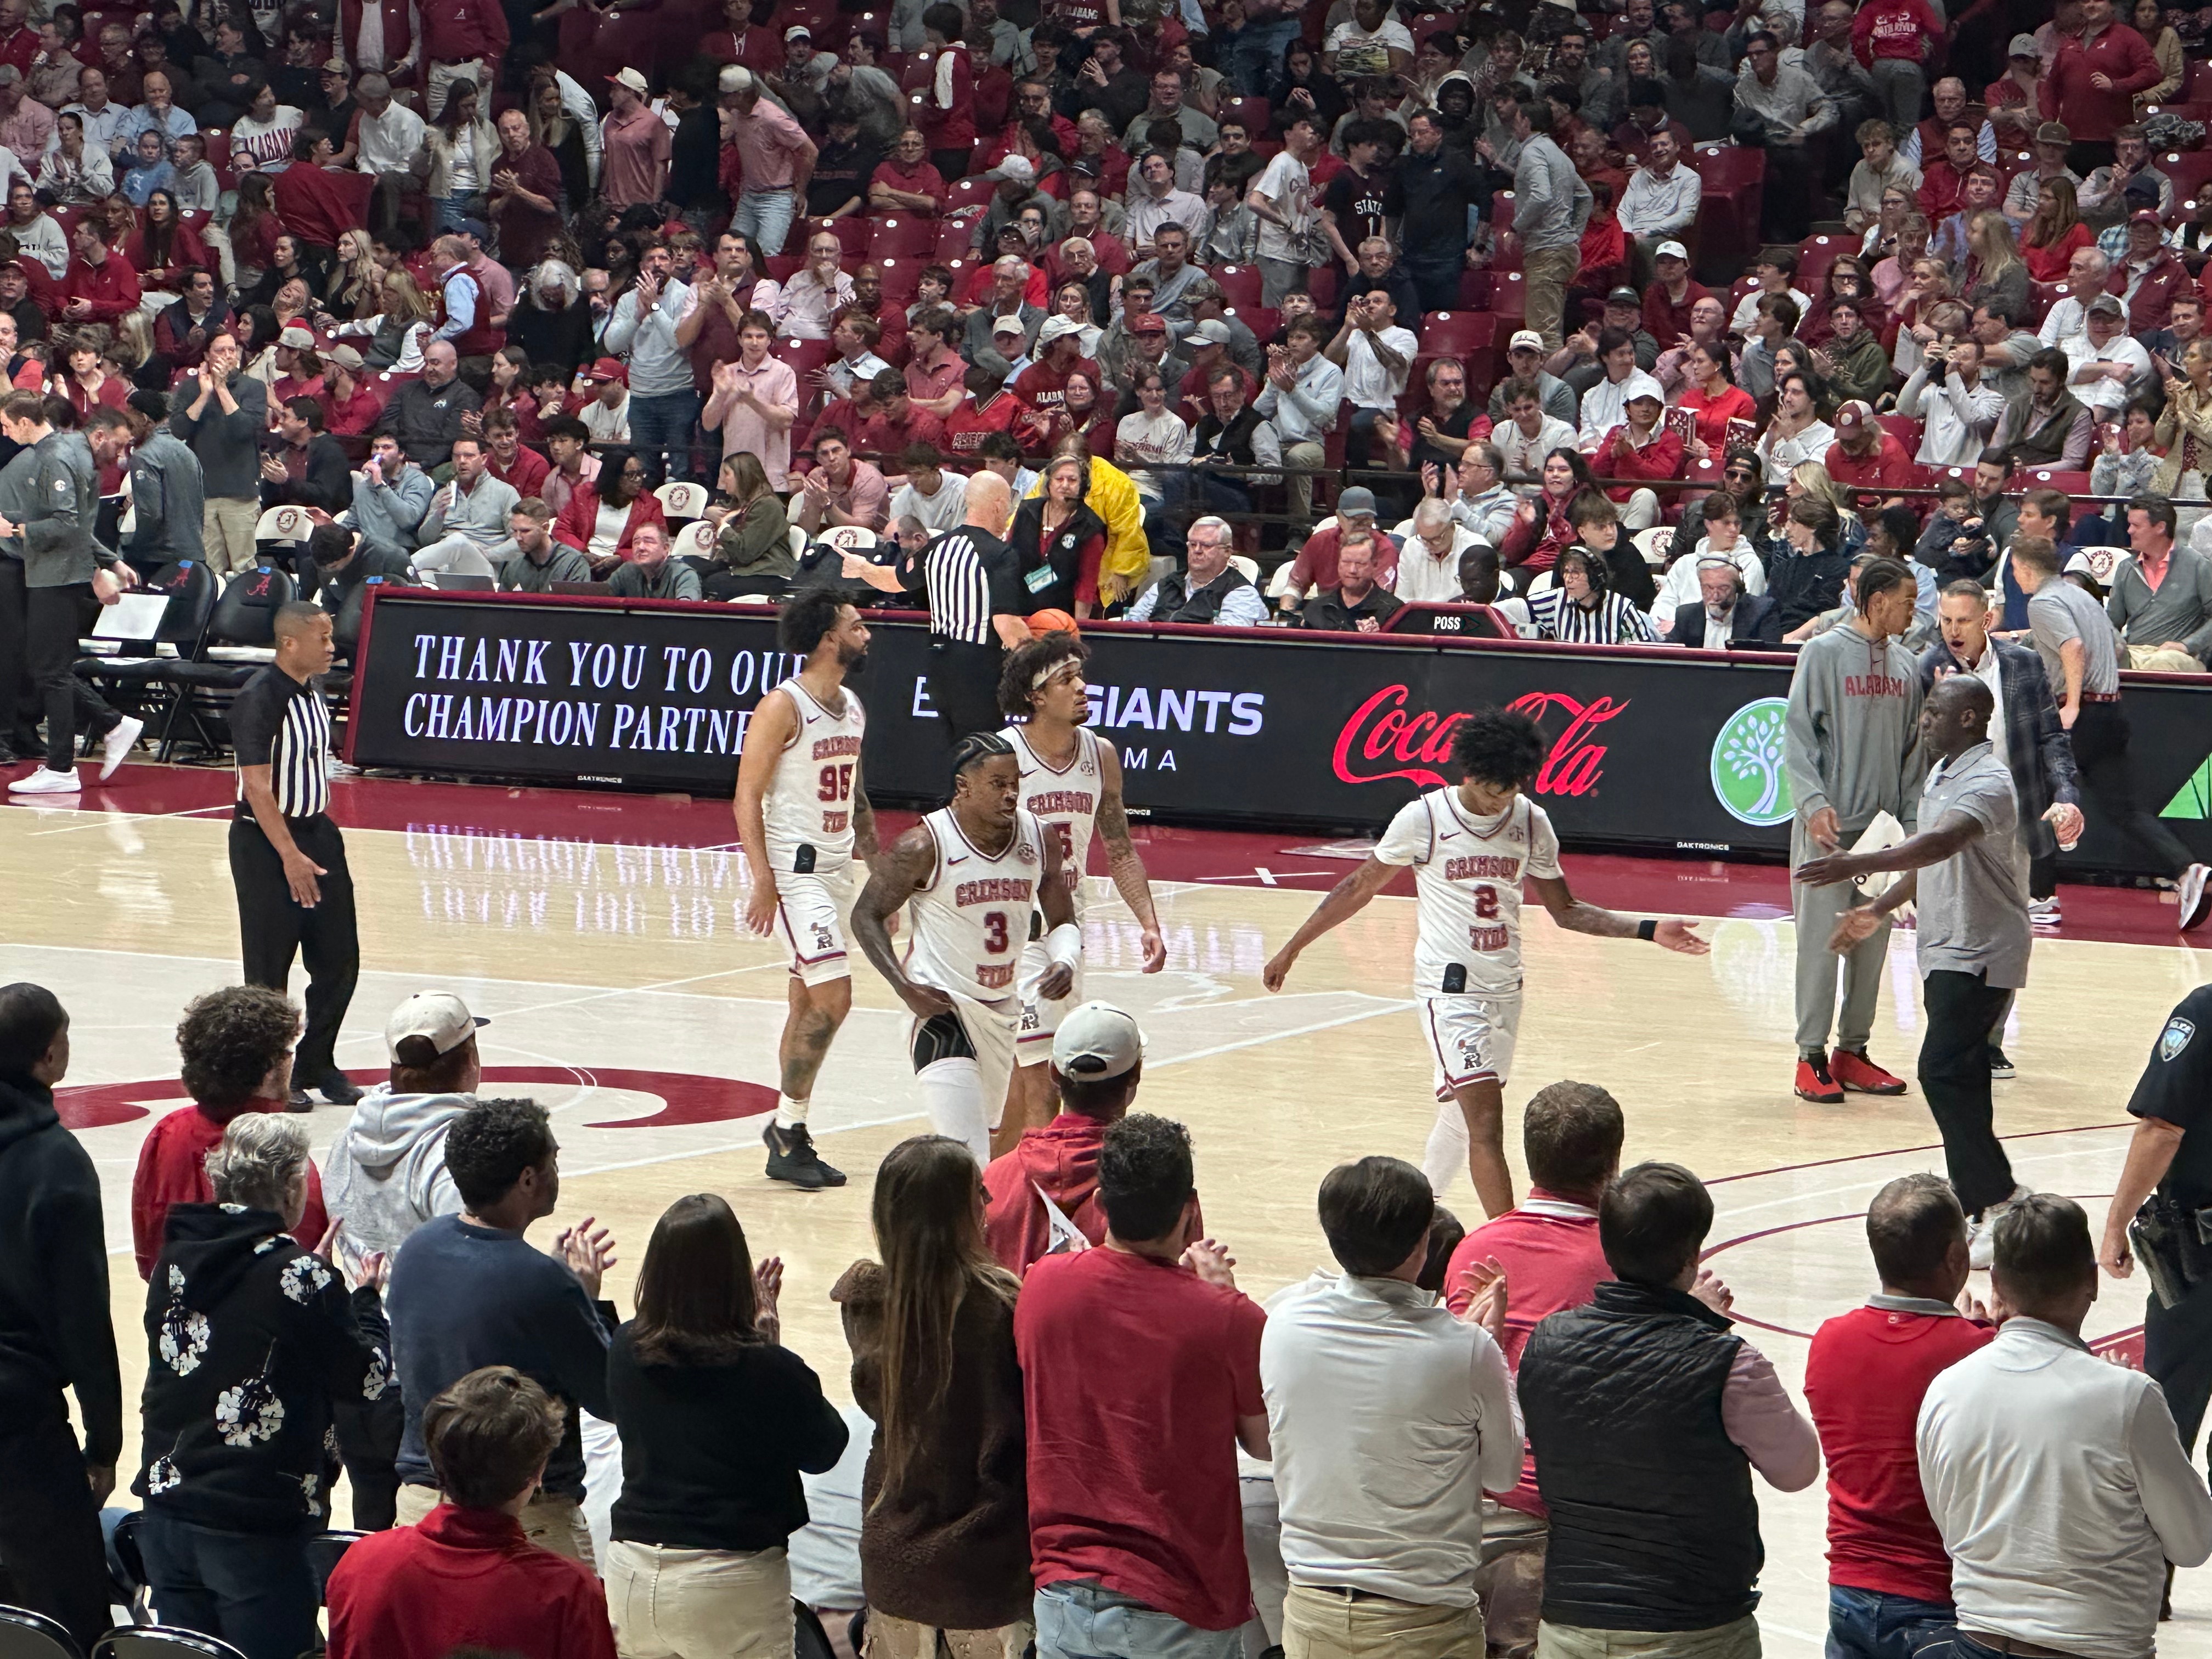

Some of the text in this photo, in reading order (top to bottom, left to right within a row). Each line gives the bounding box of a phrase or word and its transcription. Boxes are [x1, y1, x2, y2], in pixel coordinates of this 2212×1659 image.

[1355, 199, 1383, 216] STATE
[1434, 616, 1461, 630] POSS
[415, 635, 551, 684] THANK
[568, 642, 647, 690] YOU
[664, 647, 712, 693] TO
[405, 693, 601, 746] CHAMPION
[1078, 685, 1264, 735] GIANTS
[817, 764, 854, 802] 95
[1026, 791, 1093, 816] CRIMSON
[1677, 842, 1729, 851] DAKTRONICS
[1444, 855, 1520, 882] CRIMSON
[955, 878, 1032, 907] CRIMSON
[1474, 884, 1499, 918] 2
[984, 910, 1009, 955] 3
